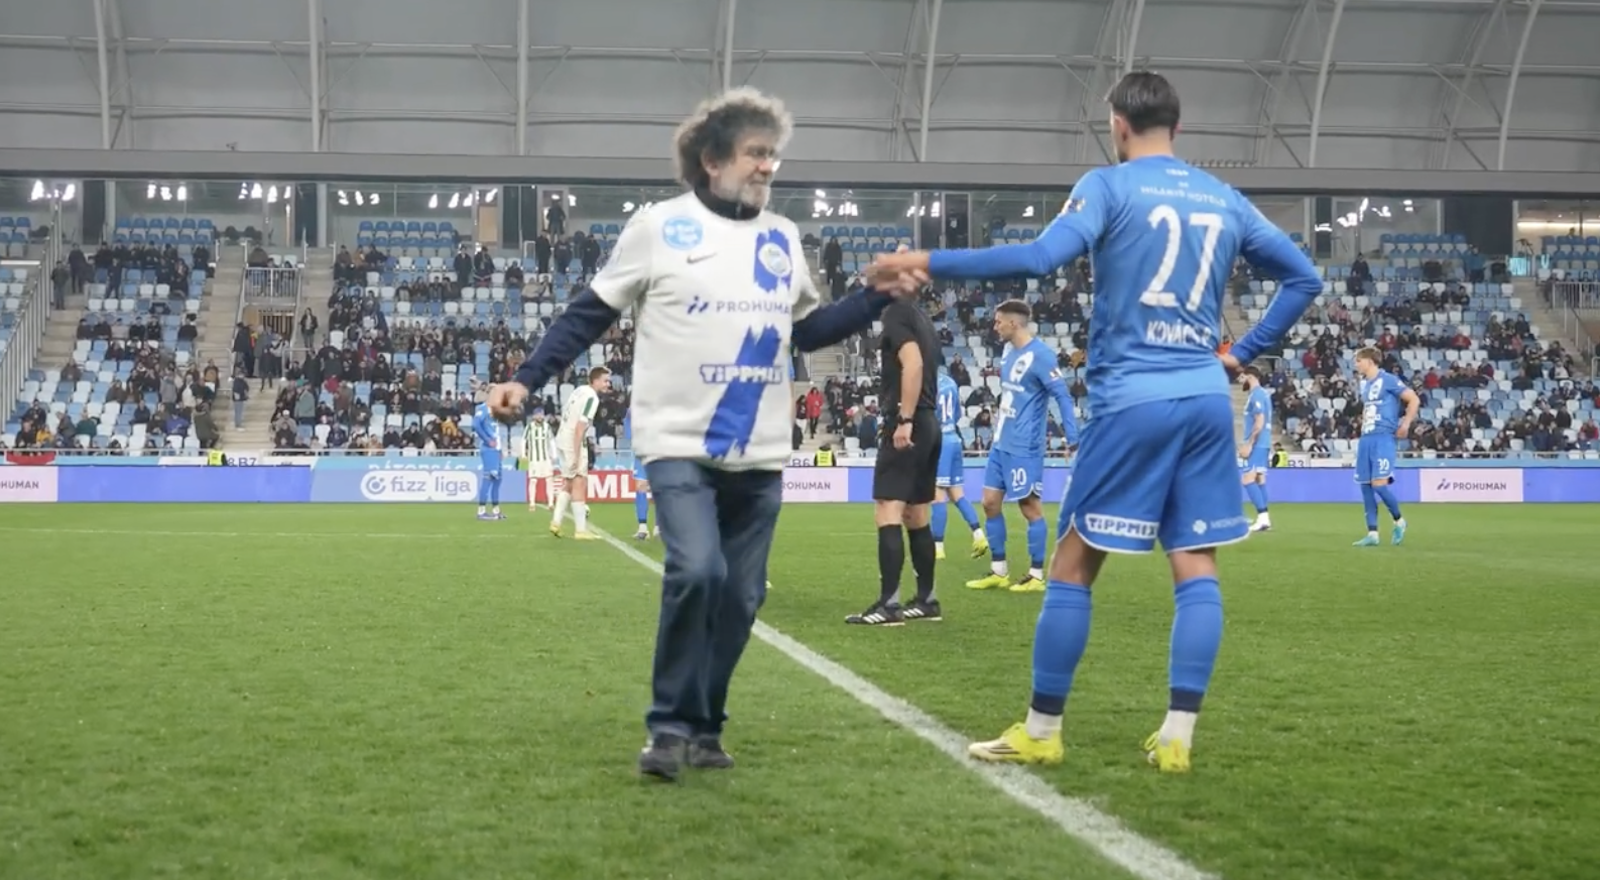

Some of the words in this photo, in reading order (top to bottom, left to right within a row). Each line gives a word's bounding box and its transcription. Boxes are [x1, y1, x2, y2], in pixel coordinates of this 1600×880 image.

[1139, 204, 1224, 312] 27
[716, 300, 790, 314] PROHUMA
[939, 390, 953, 423] 14
[0, 480, 39, 489] HUMAN
[390, 475, 427, 492] fizz
[434, 475, 471, 496] liga
[1011, 467, 1027, 486] 20
[1452, 481, 1507, 490] PROHUMAN
